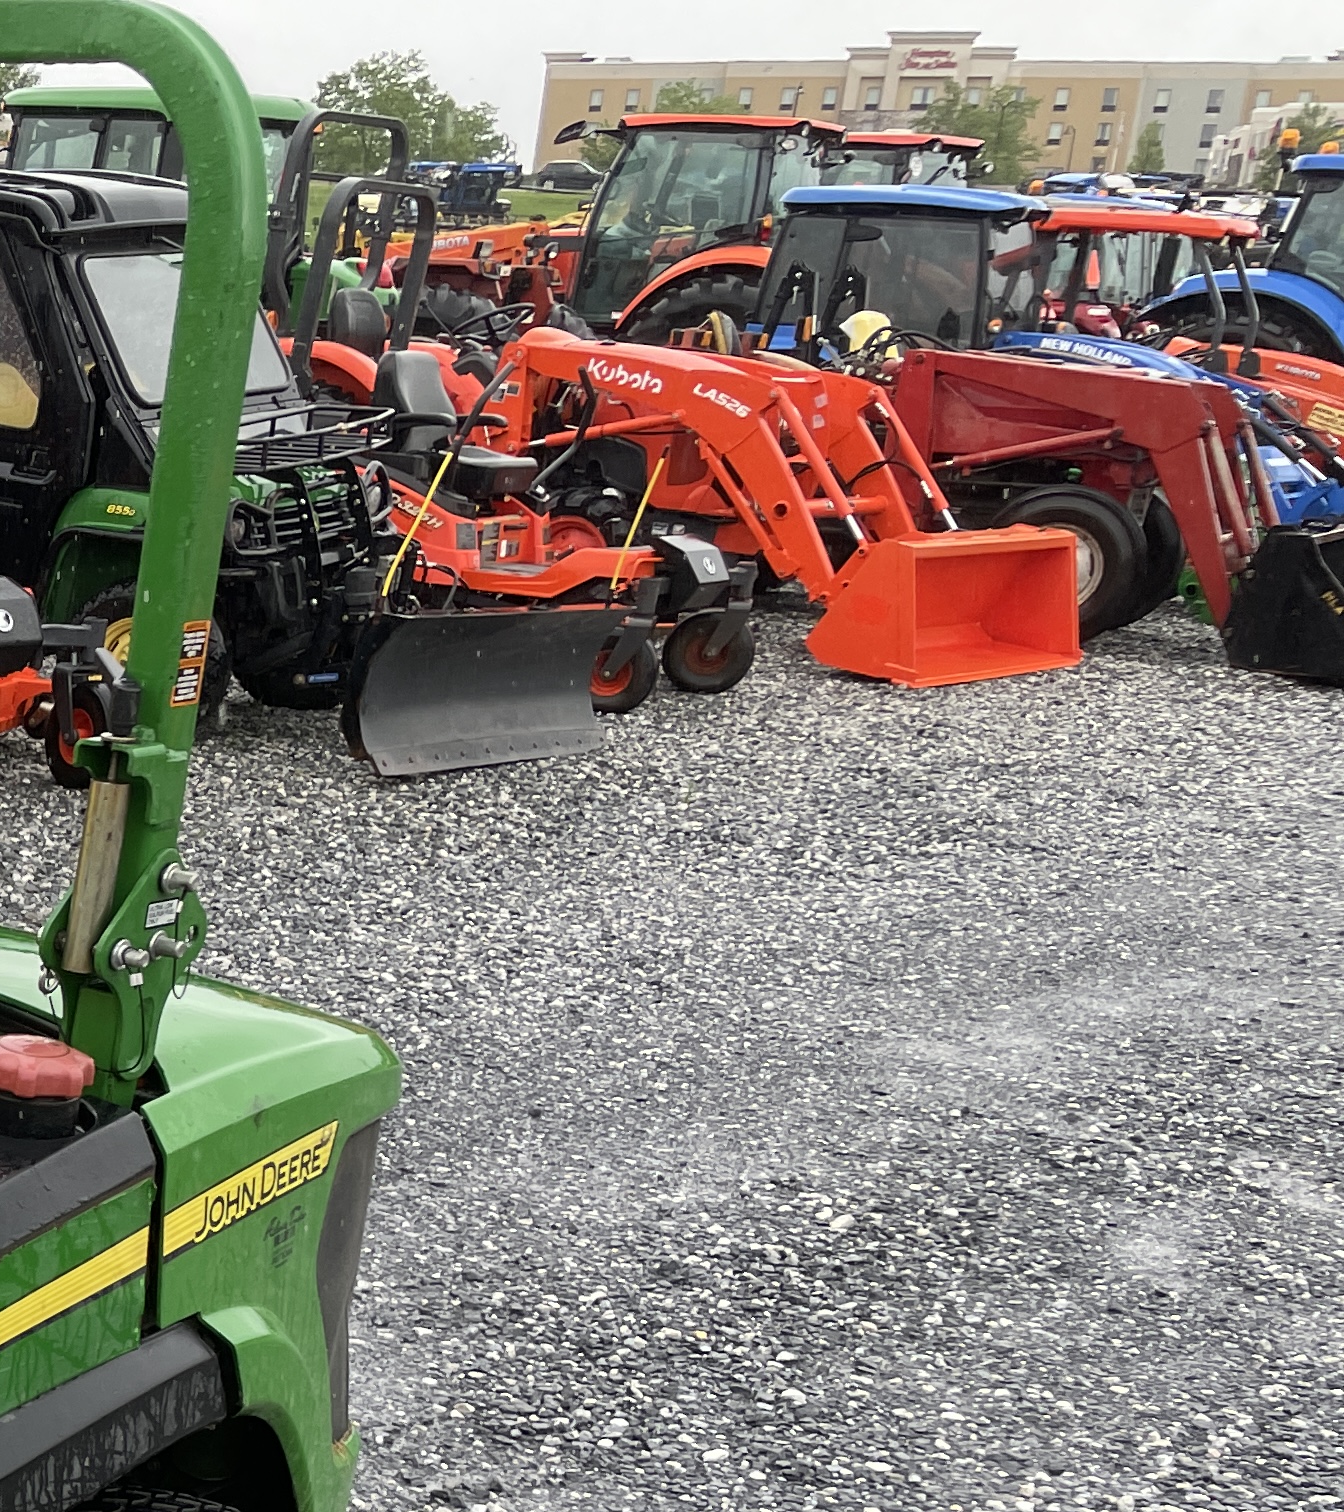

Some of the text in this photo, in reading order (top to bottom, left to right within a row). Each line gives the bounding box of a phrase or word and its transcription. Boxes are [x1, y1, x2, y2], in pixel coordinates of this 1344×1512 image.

[433, 235, 469, 250] BOTA
[1039, 337, 1133, 364] NEW HOLLAND
[587, 357, 663, 394] Kubota
[693, 383, 752, 418] LA526
[195, 1176, 257, 1239] JOHN
[260, 1142, 324, 1201] DEERE
